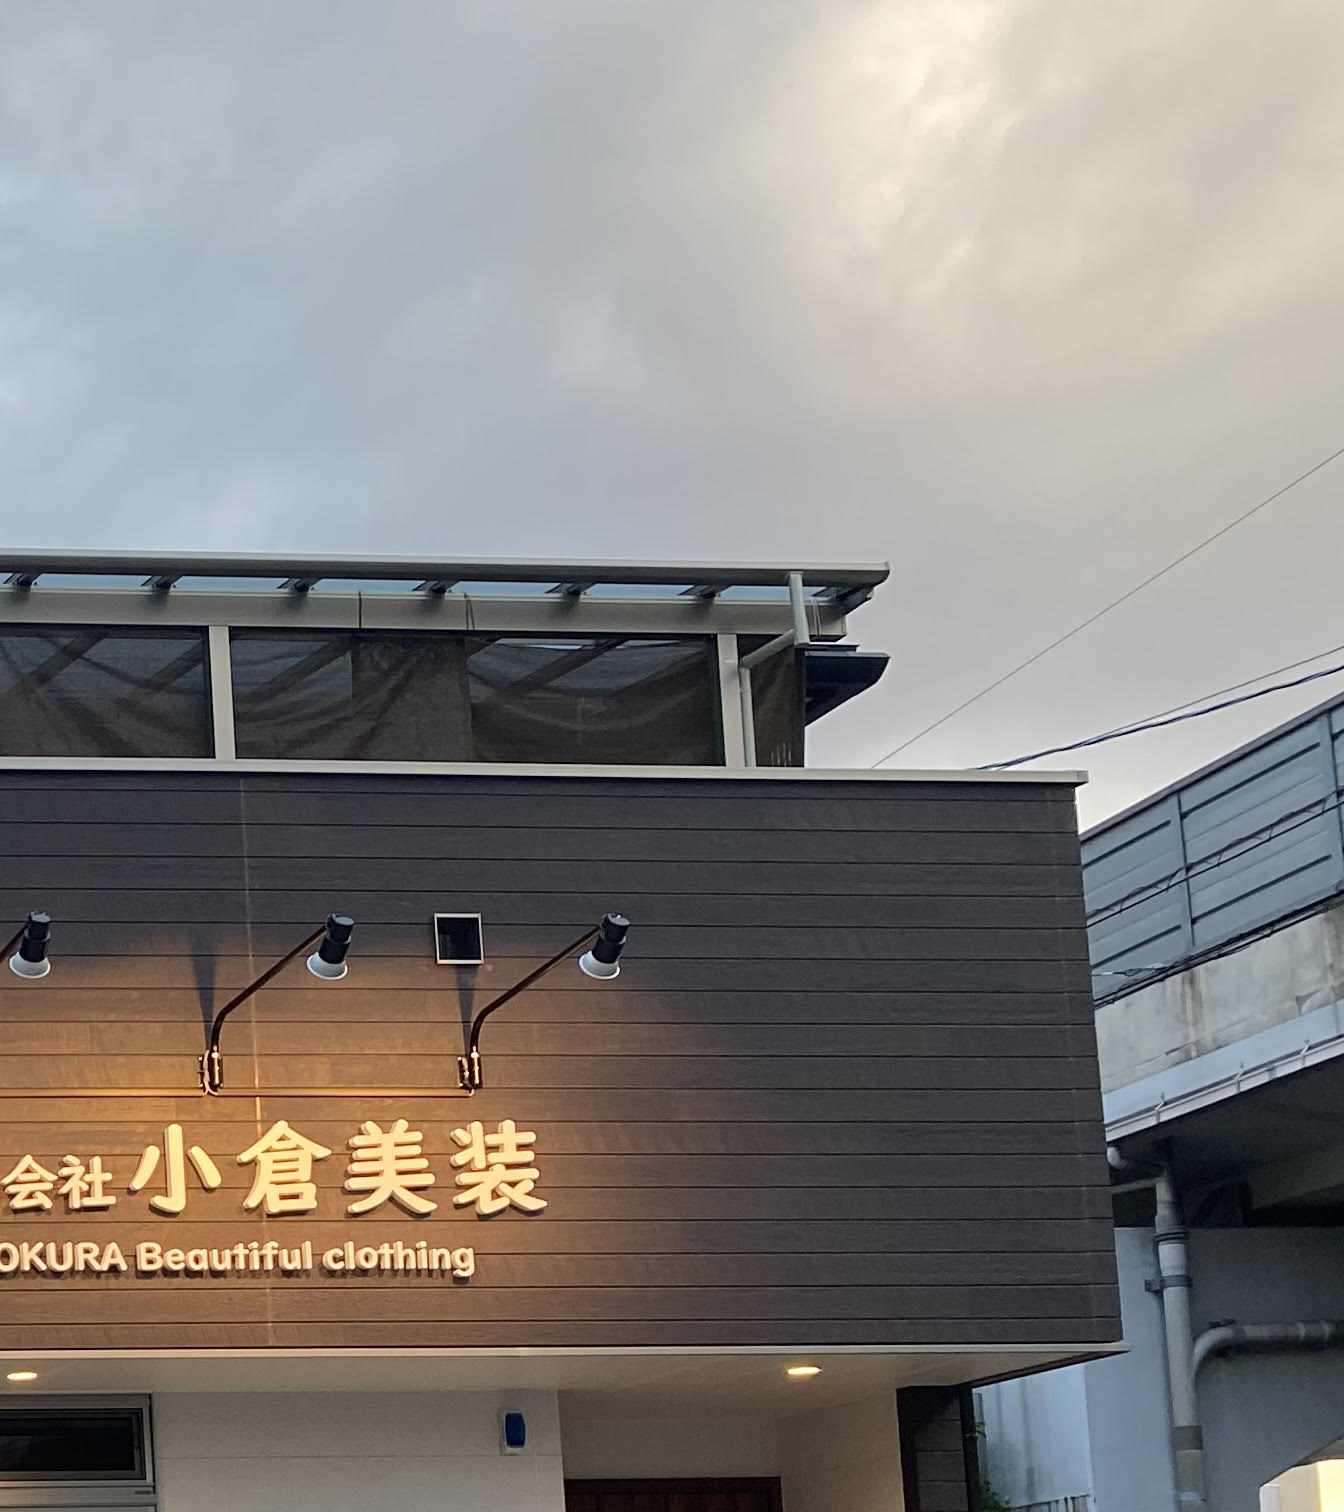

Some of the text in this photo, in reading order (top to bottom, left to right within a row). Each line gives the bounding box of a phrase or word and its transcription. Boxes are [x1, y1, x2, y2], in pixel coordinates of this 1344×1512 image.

[129, 1118, 548, 1215] 小倉美装
[136, 1241, 312, 1273] Beautiful
[322, 1241, 475, 1279] clothing
